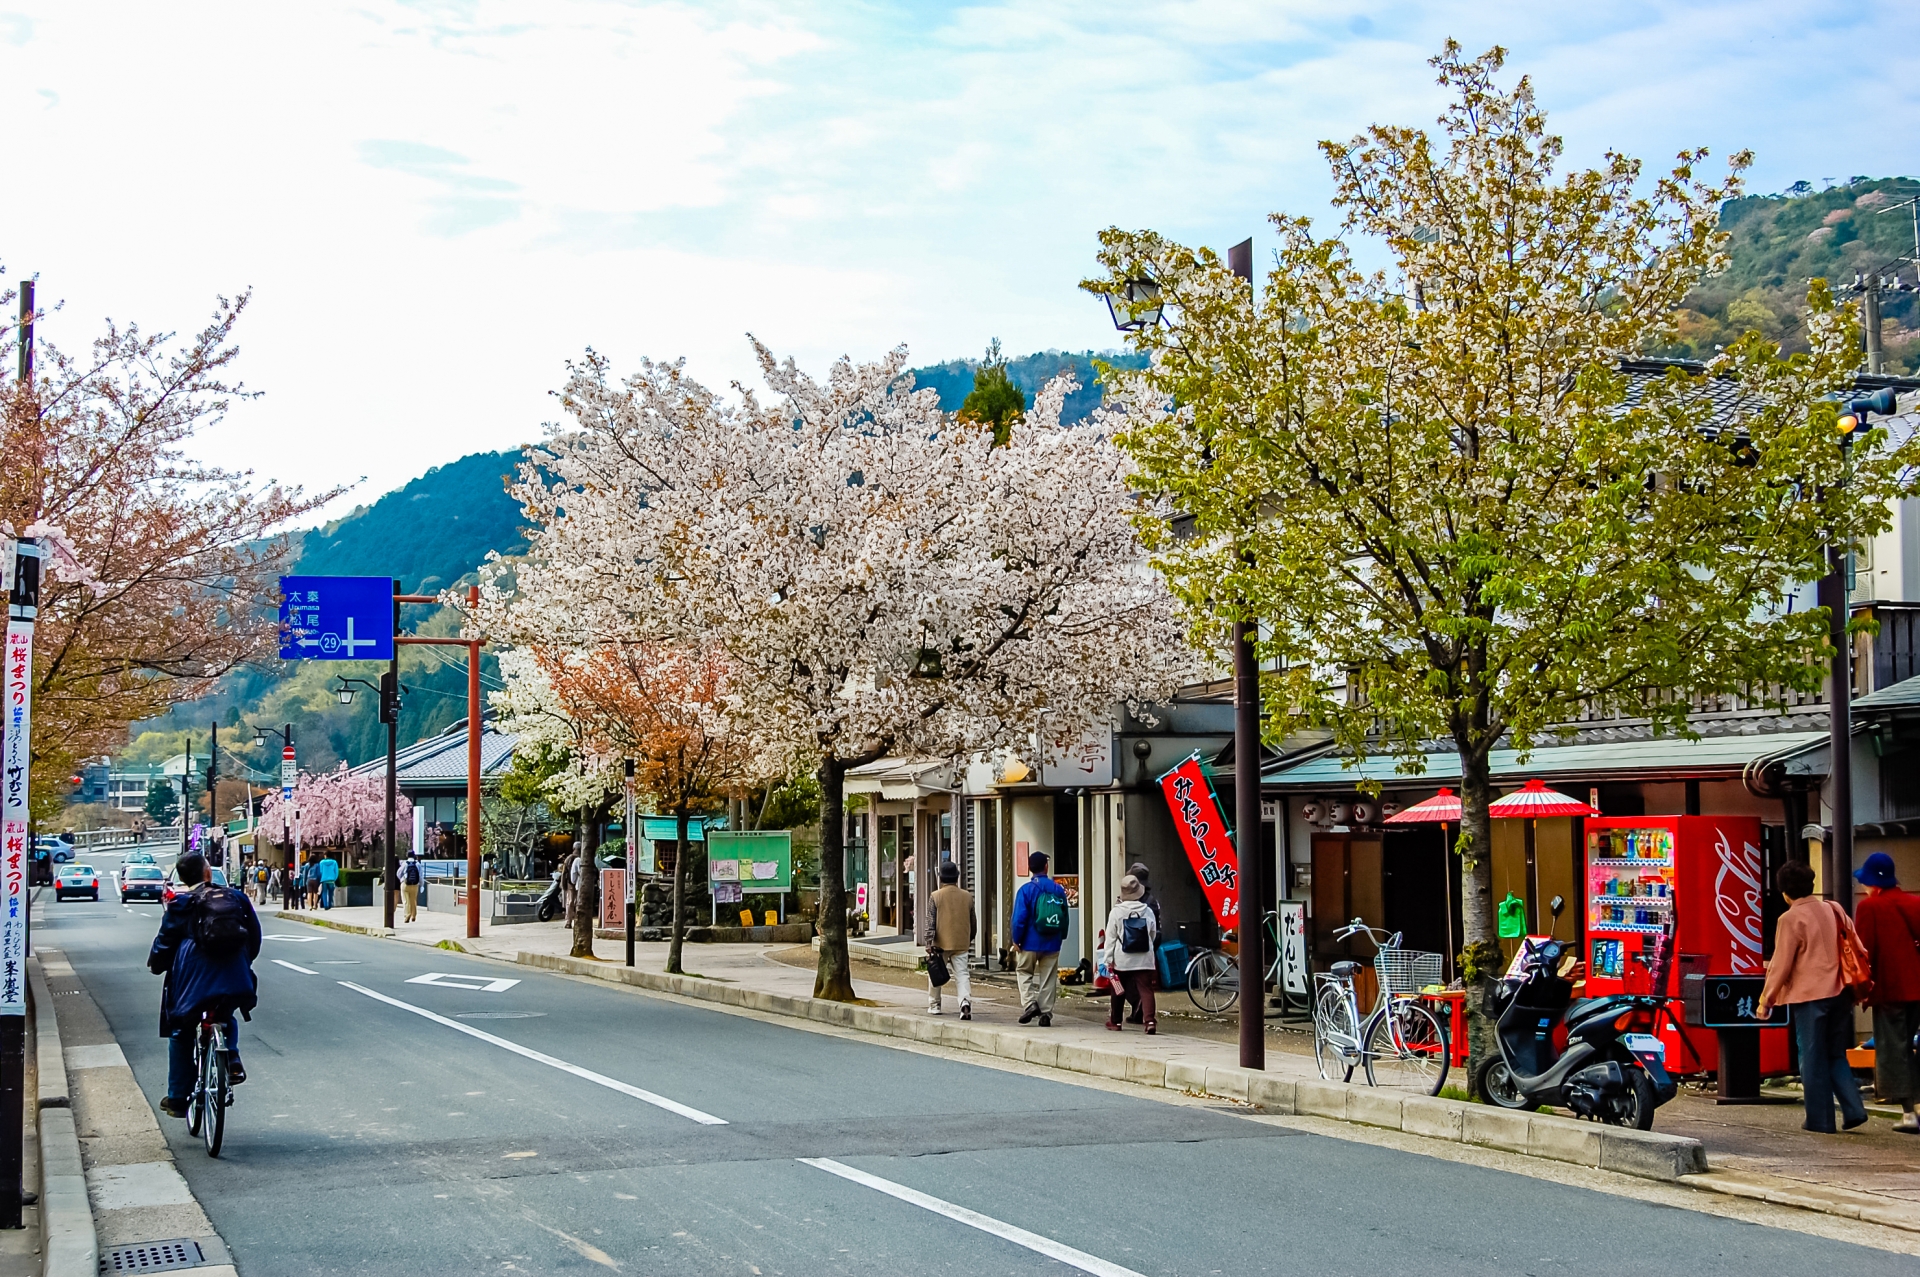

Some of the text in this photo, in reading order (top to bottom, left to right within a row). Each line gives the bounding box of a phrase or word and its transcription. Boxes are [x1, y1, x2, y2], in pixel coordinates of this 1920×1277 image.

[289, 590, 319, 603] 太秦
[10, 633, 29, 645] 嵐山
[324, 637, 337, 649] 29
[10, 647, 27, 706] 桜まつり
[5, 822, 25, 834] 嵐山
[6, 836, 24, 897] 桜まつり
[1284, 911, 1298, 989] だんご
